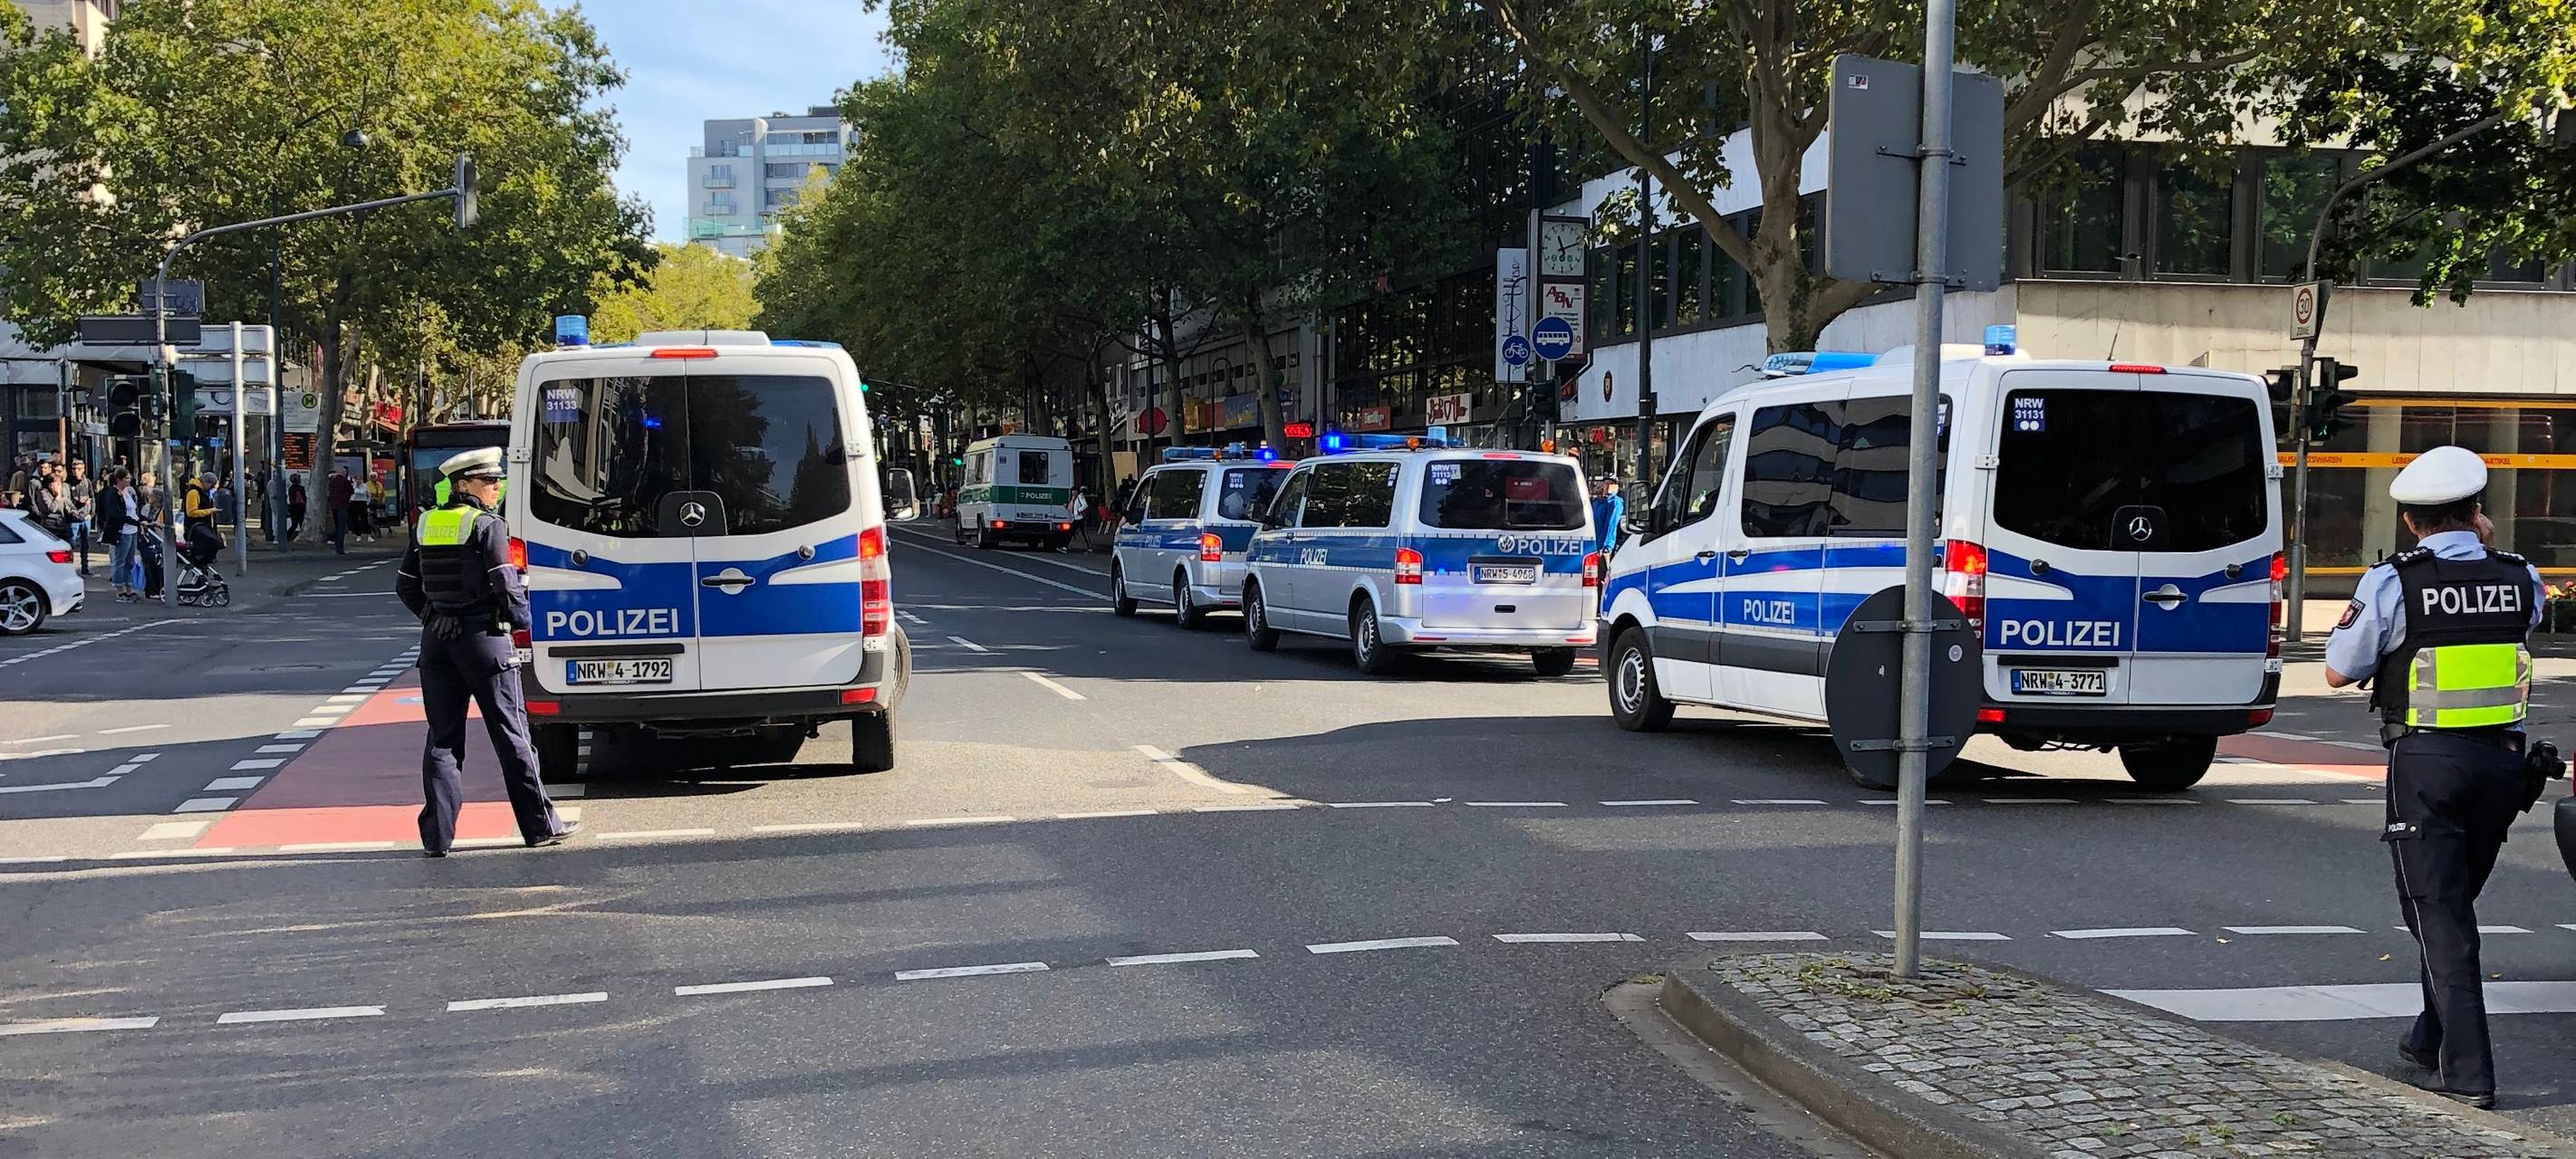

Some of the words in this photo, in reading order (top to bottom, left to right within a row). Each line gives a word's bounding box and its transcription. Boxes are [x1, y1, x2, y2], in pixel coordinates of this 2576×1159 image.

[1546, 286, 1572, 308] ABN
[2300, 298, 2309, 314] 30
[547, 388, 576, 399] NRW
[2014, 398, 2043, 407] NRW
[547, 400, 578, 410] 31133
[2014, 410, 2043, 418] 31131
[1300, 547, 1329, 566] POLIZEI
[1517, 539, 1583, 556] POLIZEI
[1481, 569, 1497, 579] NRW
[2422, 585, 2522, 616] POLIZEI
[1744, 599, 1795, 625] POLIZEI
[546, 608, 679, 637] POLIZEI
[2000, 619, 2120, 647] POLIZEI
[577, 662, 606, 678] NRW
[615, 660, 669, 678] 4-1792
[2021, 672, 2047, 689] NRW
[2055, 673, 2104, 691] 4-3771
